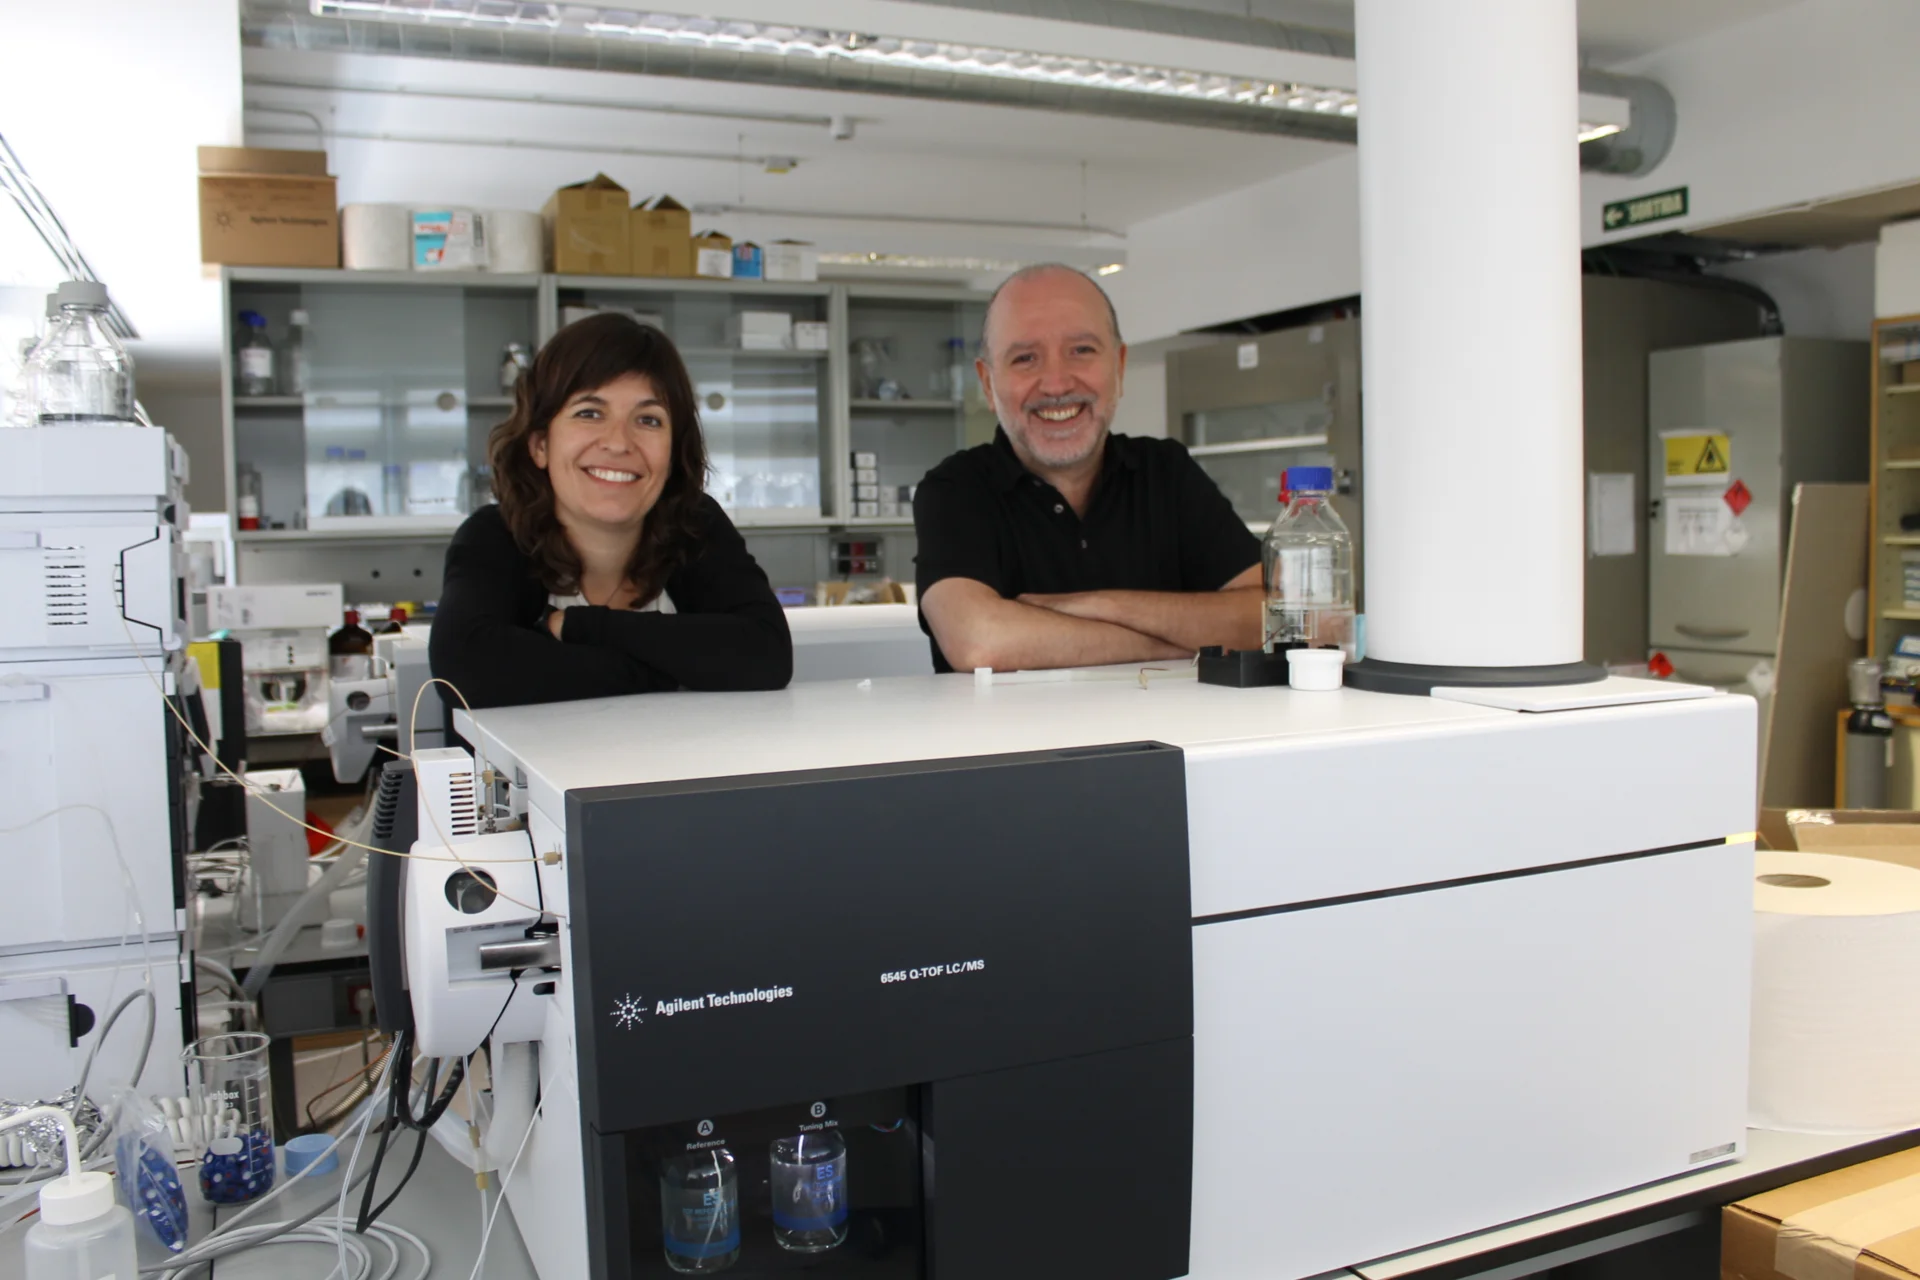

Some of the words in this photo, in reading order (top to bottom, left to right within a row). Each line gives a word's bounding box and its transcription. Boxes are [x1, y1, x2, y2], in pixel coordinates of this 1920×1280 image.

[880, 970, 907, 984] 6545
[909, 965, 943, 979] Q-TOF
[945, 959, 985, 975] LC/MS
[655, 997, 705, 1016] Agilent
[706, 985, 793, 1003] Technologies
[813, 1103, 824, 1116] B
[699, 1121, 711, 1134] A
[799, 1122, 824, 1132] Tuning
[824, 1120, 839, 1128] Mix
[686, 1139, 725, 1151] Reference
[816, 1165, 833, 1180] ES
[703, 1190, 721, 1206] ES
